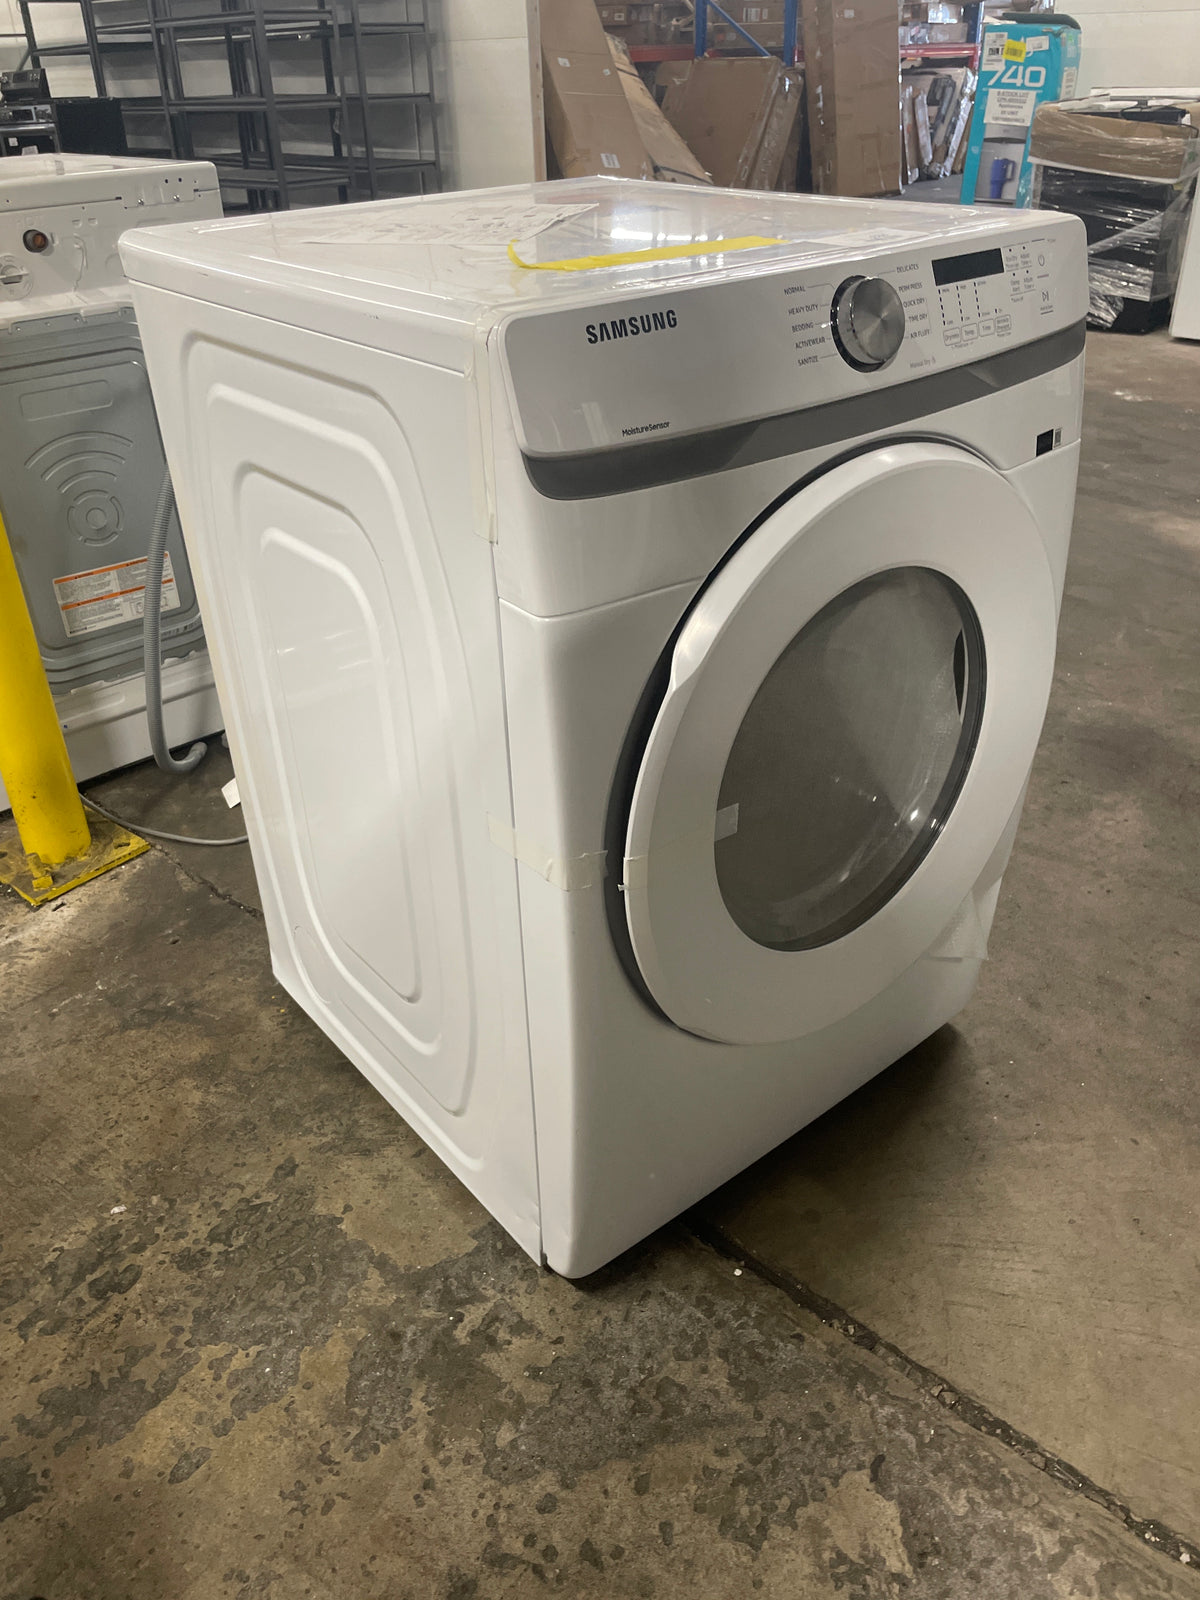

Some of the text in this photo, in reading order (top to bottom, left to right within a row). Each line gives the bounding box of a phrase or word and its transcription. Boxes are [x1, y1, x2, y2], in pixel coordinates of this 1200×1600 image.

[987, 65, 1046, 88] 740
[896, 263, 919, 273] DELICATES
[783, 286, 806, 295] NORMAL
[898, 282, 923, 293] PERM PRESS
[903, 297, 925, 308] QUICK DRY
[788, 304, 819, 316] HEAVY DUTY
[908, 314, 919, 322] TIME
[585, 309, 678, 345] SAMSUNG
[791, 322, 814, 333] BEDDING
[795, 336, 826, 349] ACTIVEWEAR
[797, 355, 819, 367] SANITIZE
